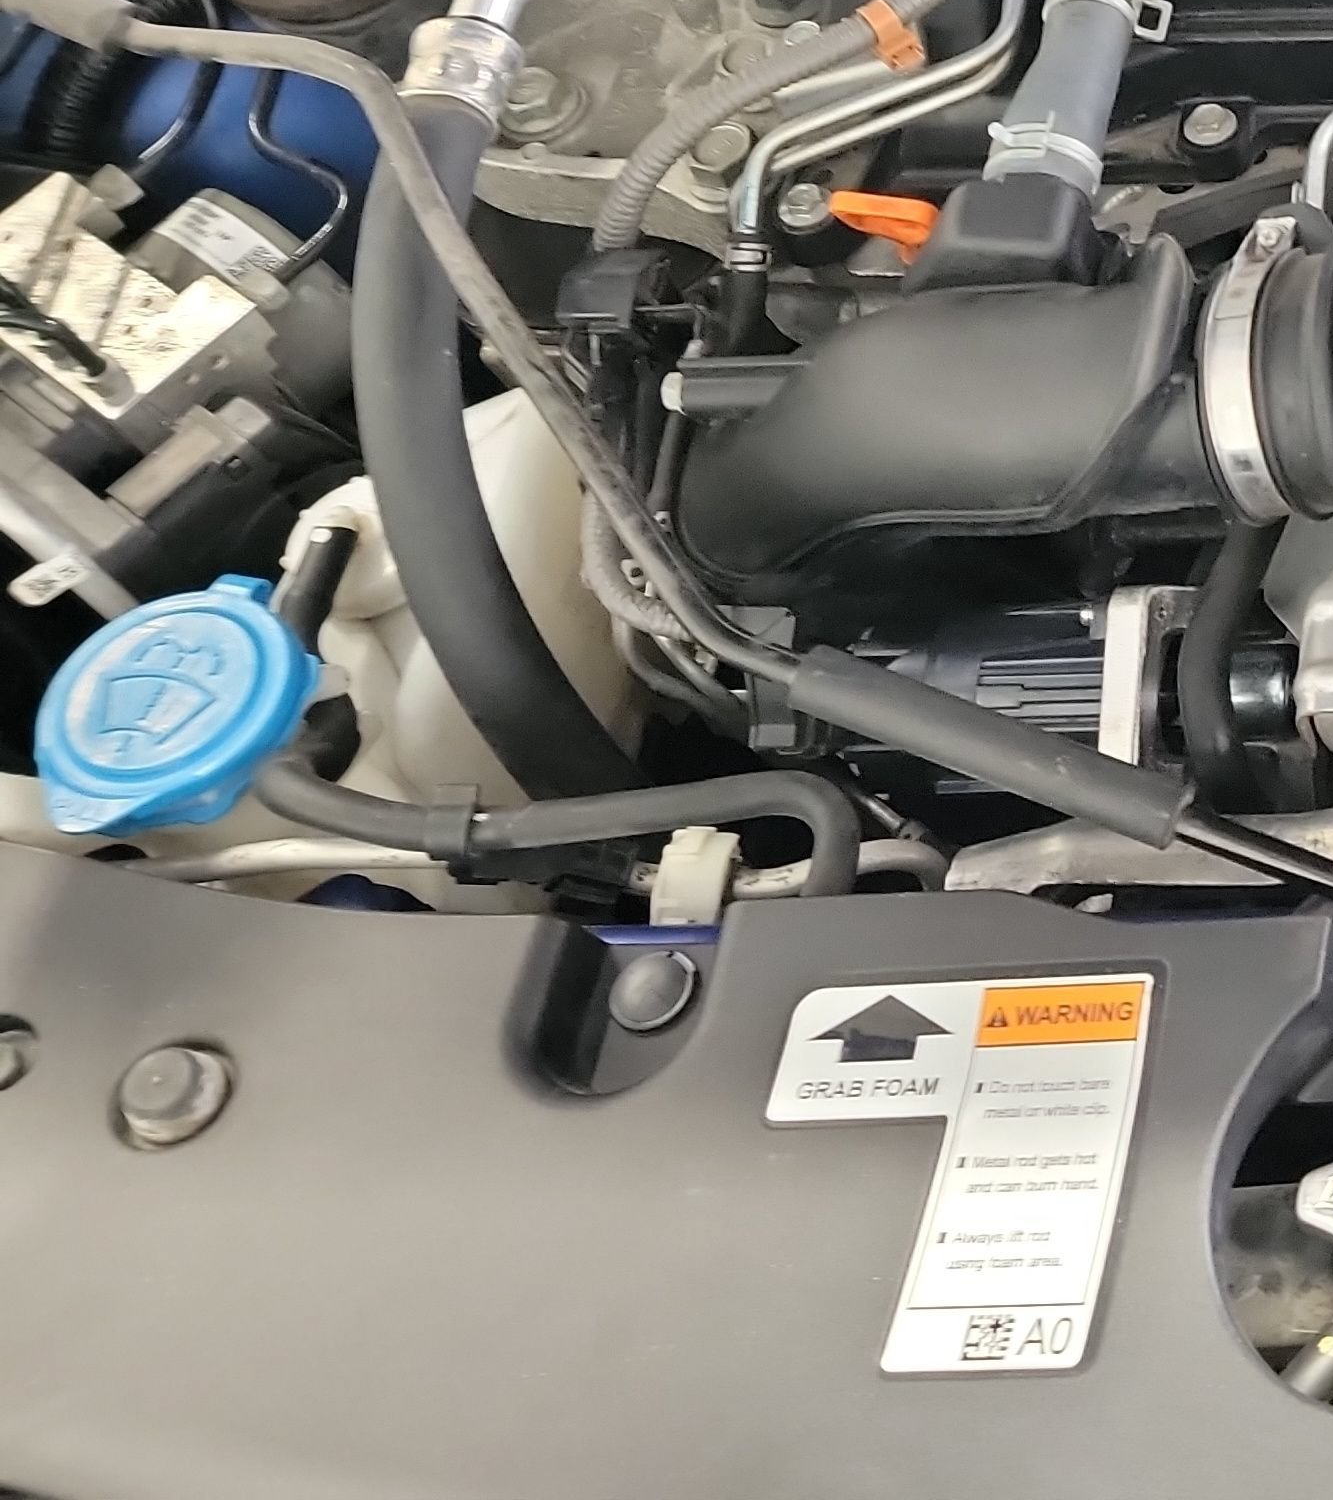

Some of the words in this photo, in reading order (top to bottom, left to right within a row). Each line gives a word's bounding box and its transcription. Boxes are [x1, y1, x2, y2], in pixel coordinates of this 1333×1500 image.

[1016, 1001, 1134, 1026] WARNING
[796, 1079, 864, 1100] GRAB
[870, 1077, 940, 1097] FOAM
[989, 1081, 1009, 1093] Do
[1013, 1081, 1035, 1093] not
[972, 1156, 1010, 1169] Metal
[1073, 1154, 1097, 1165] hot
[952, 1232, 1004, 1246] Always
[1016, 1317, 1073, 1355] A0
